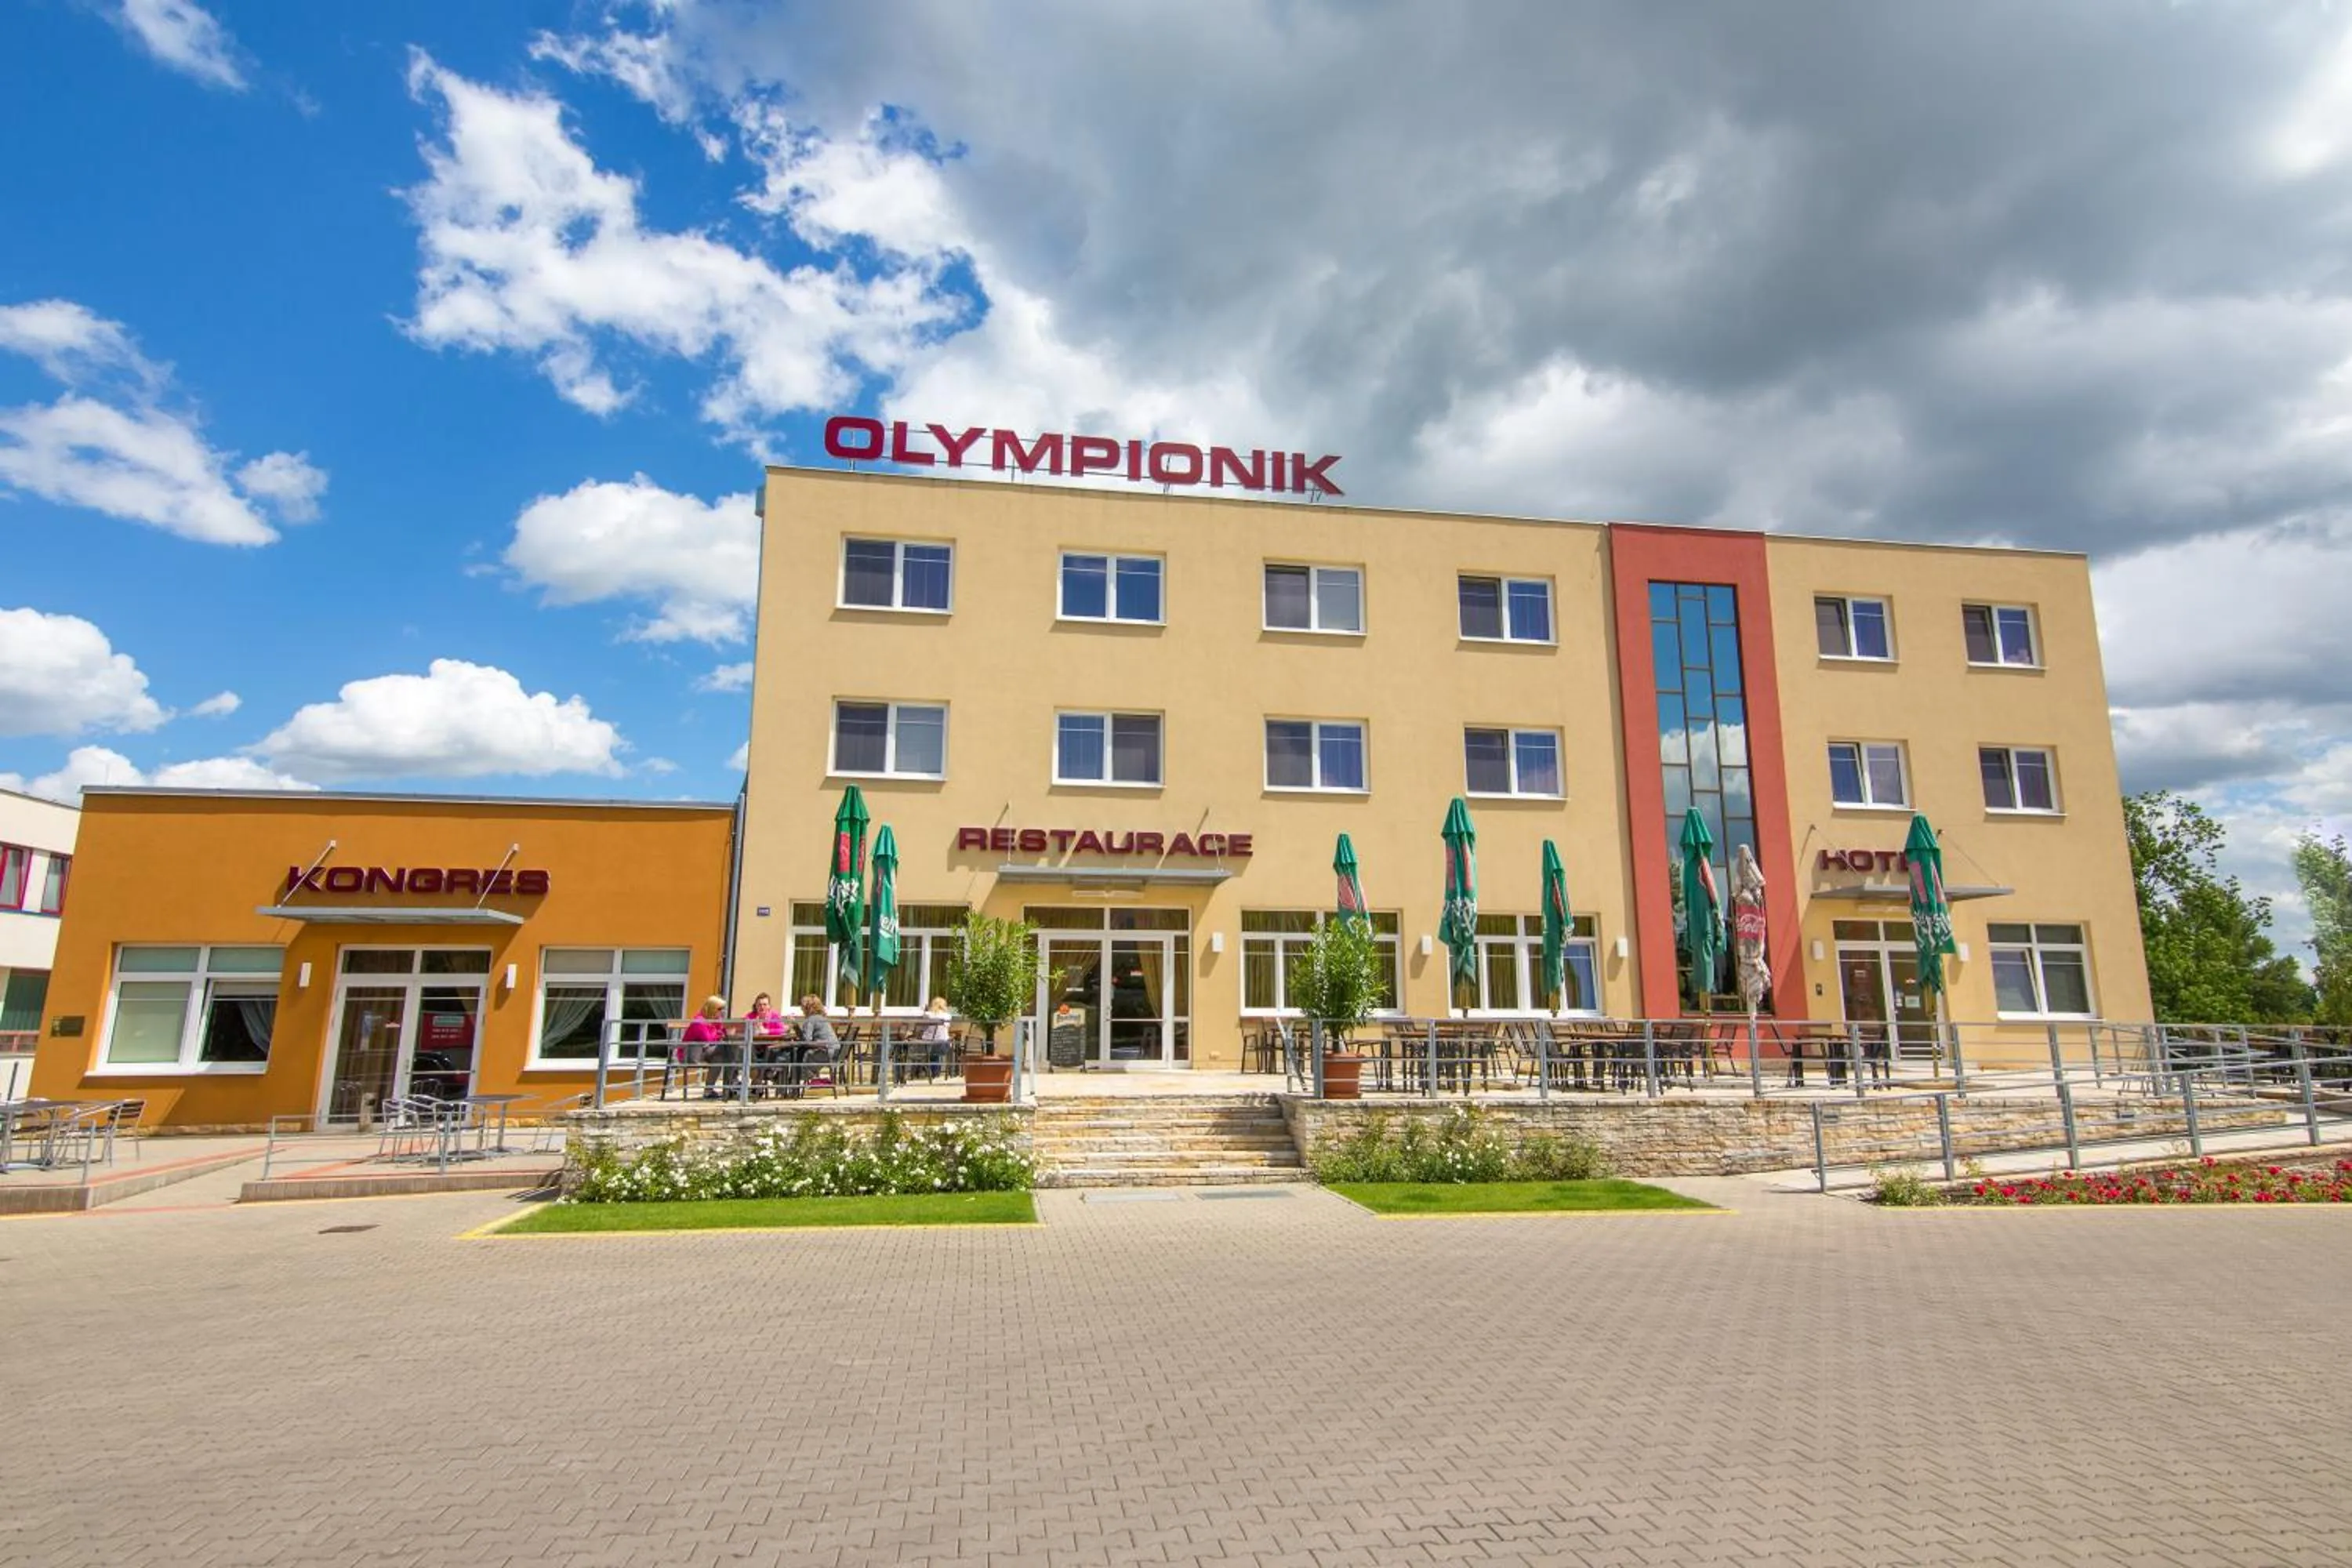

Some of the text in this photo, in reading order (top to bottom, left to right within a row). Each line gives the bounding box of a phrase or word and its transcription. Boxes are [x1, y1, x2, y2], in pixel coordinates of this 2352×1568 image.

[823, 416, 1345, 496] OLYMPIONIK
[958, 826, 1254, 857] RESTAURACE
[1818, 848, 1908, 873] HOT
[286, 865, 550, 895] KONGRES
